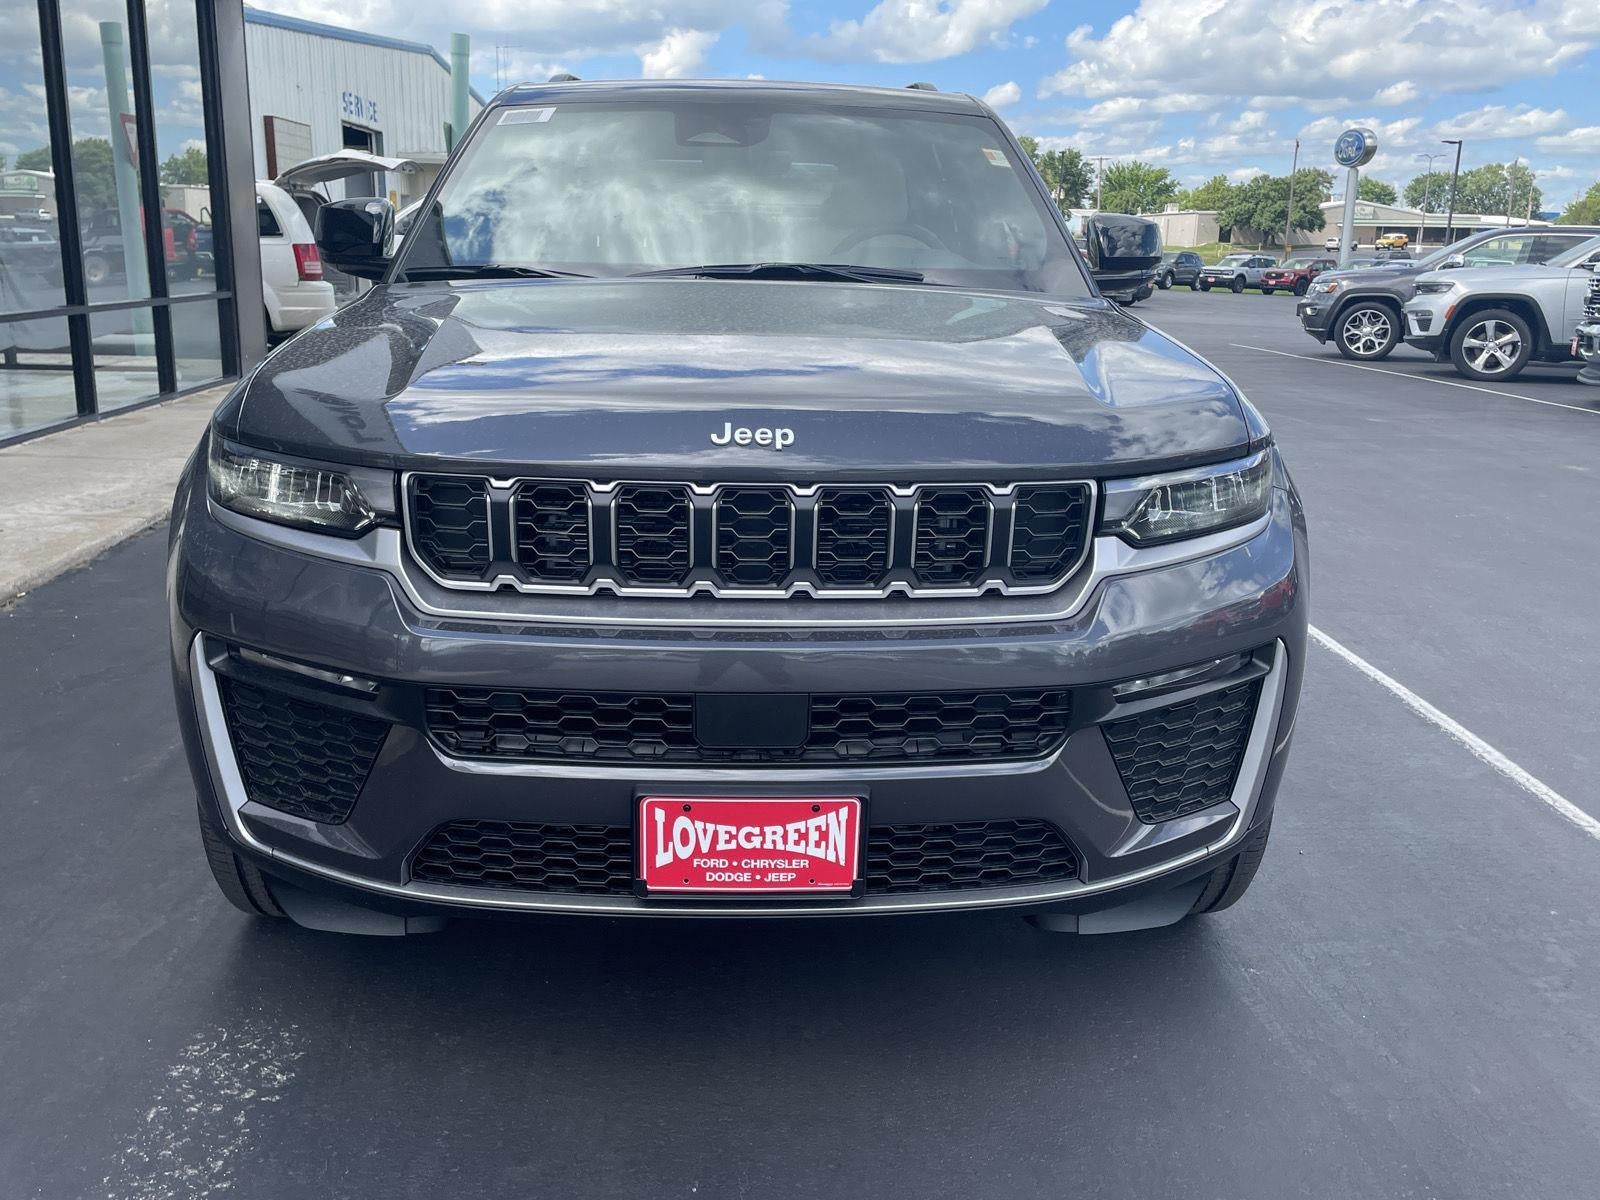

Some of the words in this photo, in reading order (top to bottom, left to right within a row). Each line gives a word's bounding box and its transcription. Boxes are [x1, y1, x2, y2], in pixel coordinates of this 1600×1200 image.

[342, 91, 378, 122] SERVCE
[1338, 137, 1359, 158] Ford
[710, 422, 795, 450] Jeep
[654, 805, 849, 868] LOVEGREEN
[693, 858, 728, 868] FORD
[741, 858, 809, 868] CHRYSLER
[705, 872, 751, 882] DODGE
[764, 872, 796, 882] JEEP
